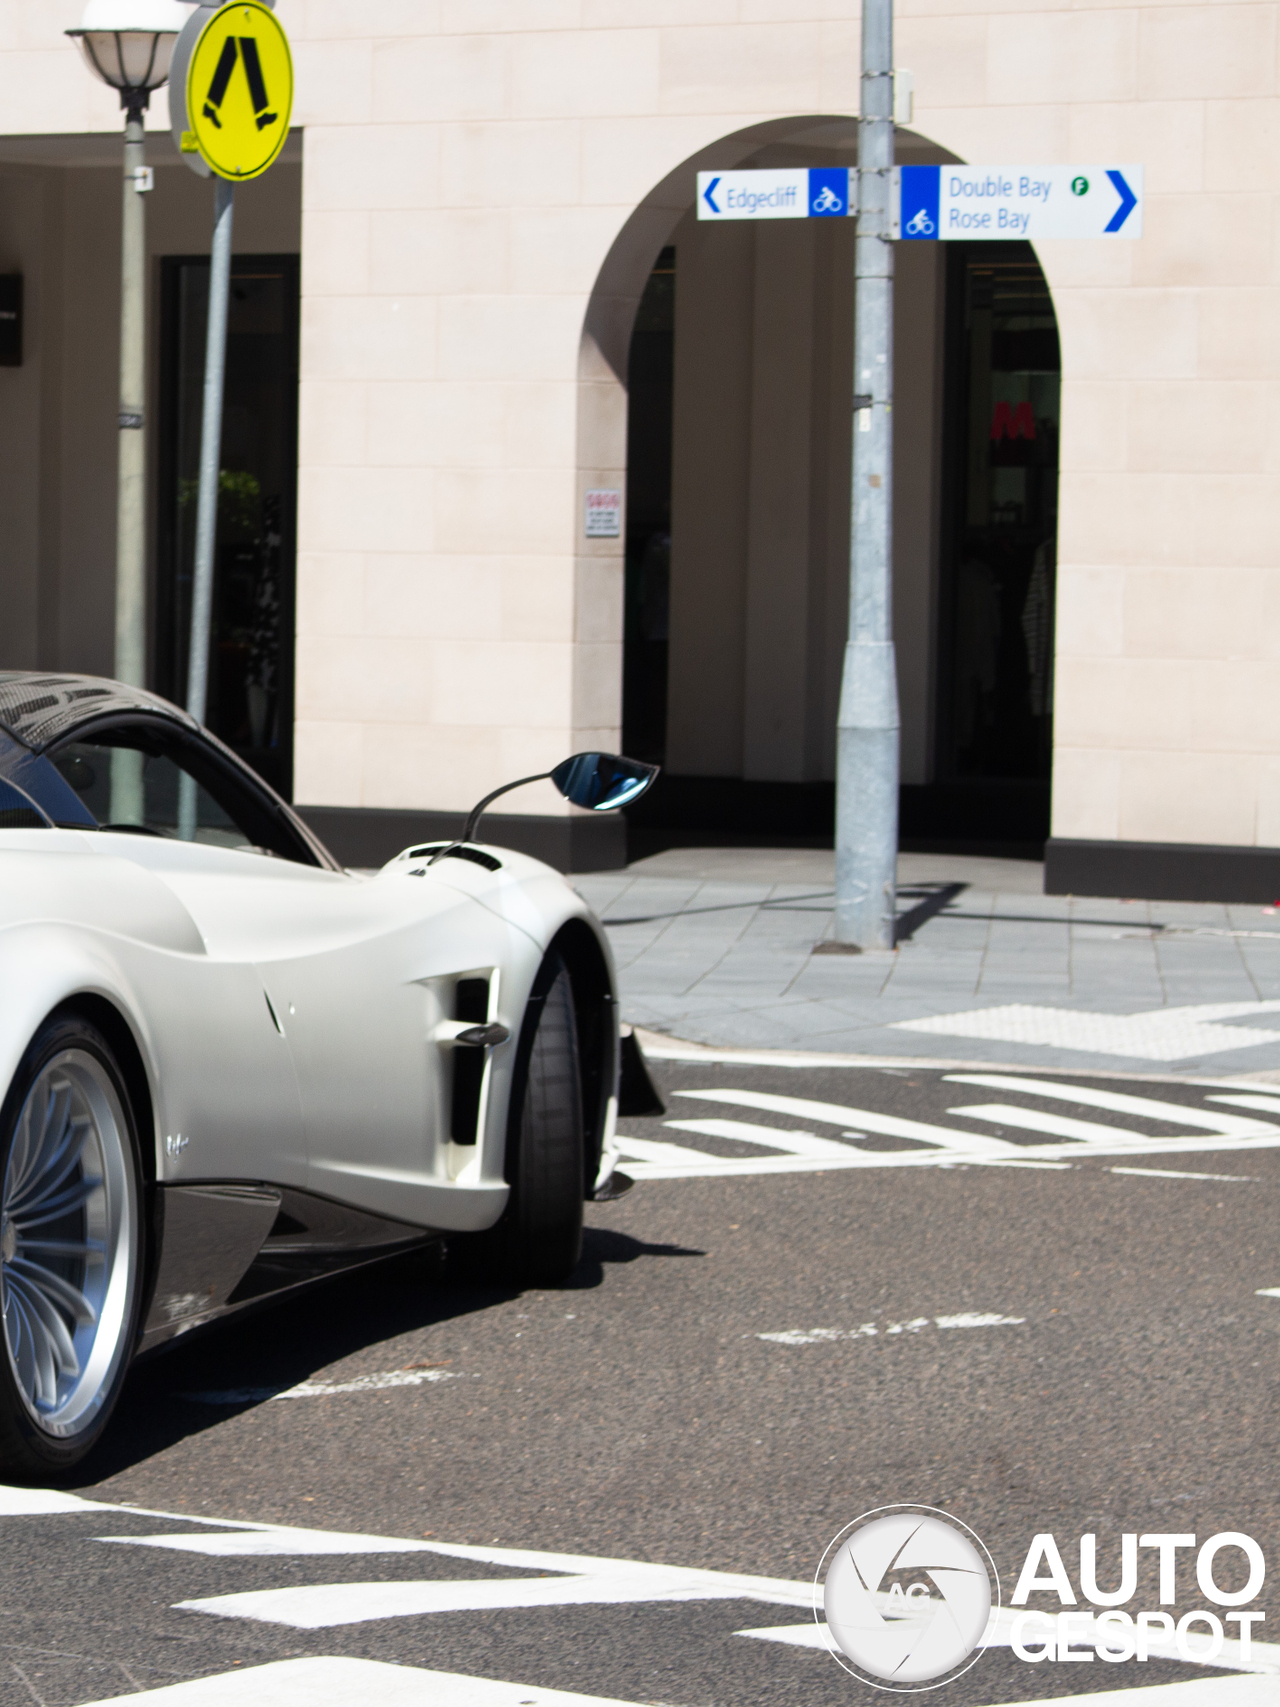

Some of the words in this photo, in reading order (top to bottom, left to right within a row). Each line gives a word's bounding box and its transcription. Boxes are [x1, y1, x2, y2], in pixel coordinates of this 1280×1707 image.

[727, 186, 797, 214] Edgecliff
[949, 175, 1013, 198] Double
[1019, 176, 1051, 203] Bay
[1072, 177, 1089, 195] F
[949, 208, 992, 229] Rose
[998, 208, 1031, 234] Bay
